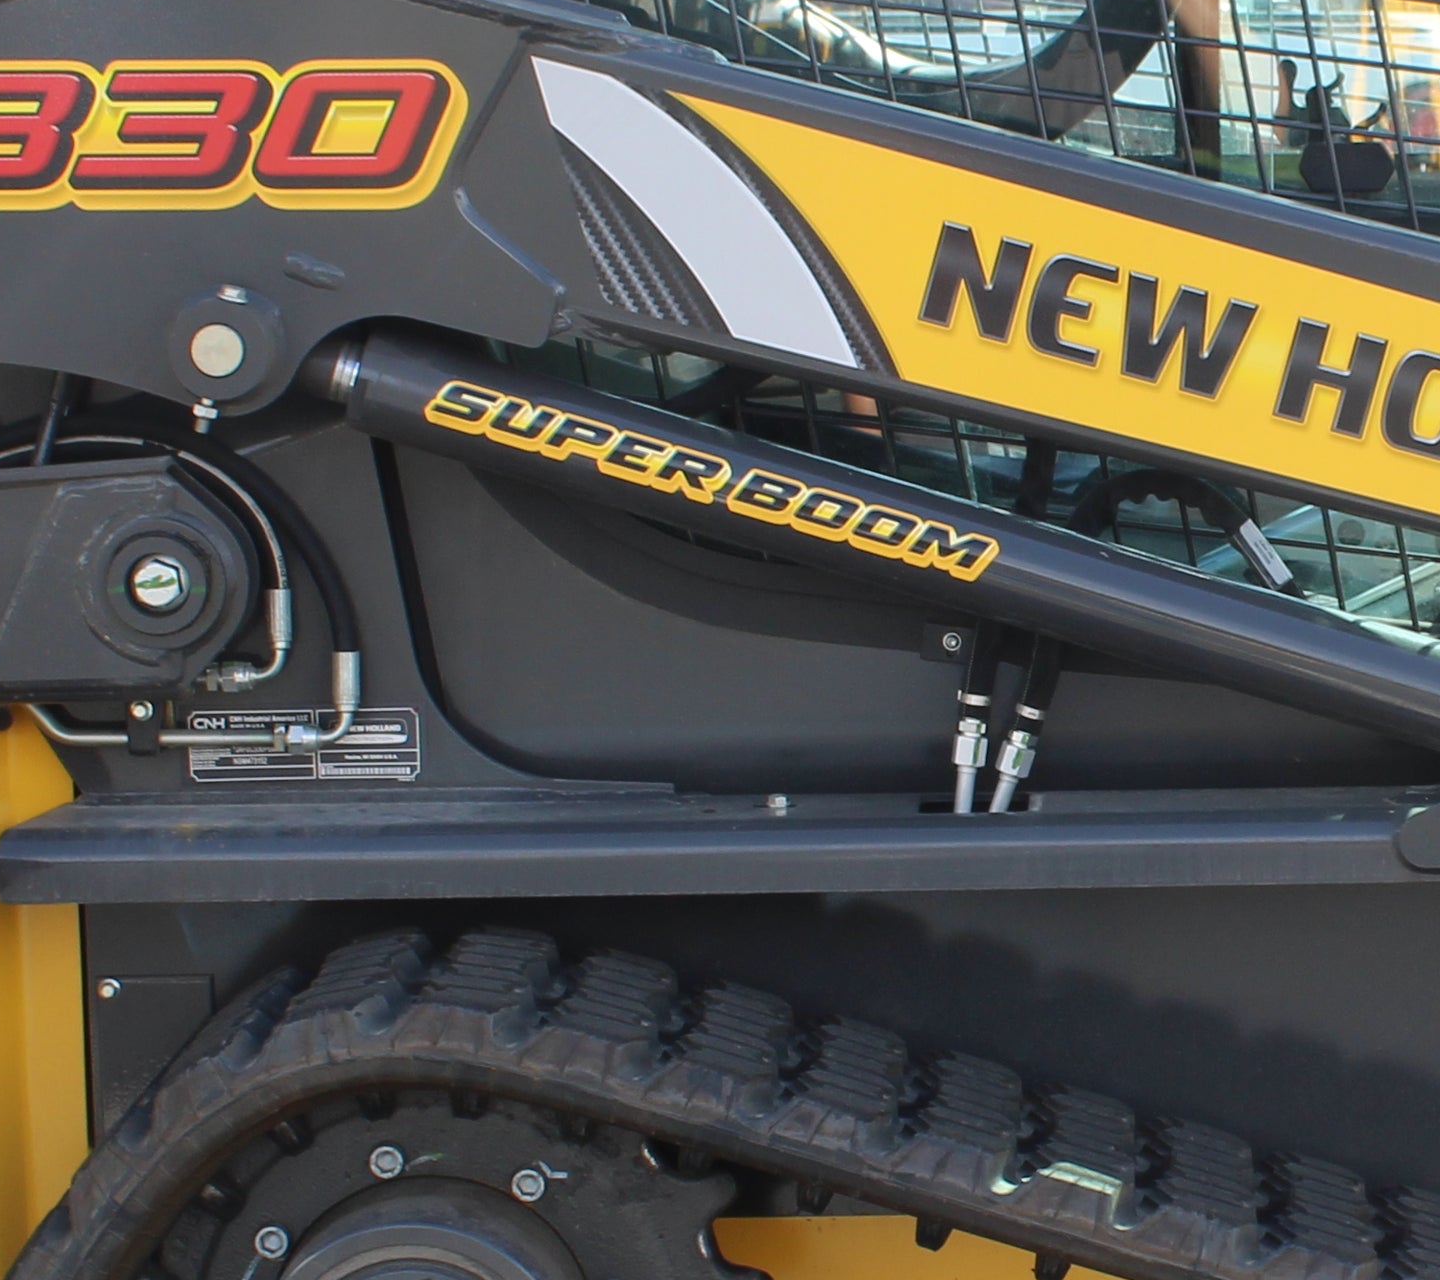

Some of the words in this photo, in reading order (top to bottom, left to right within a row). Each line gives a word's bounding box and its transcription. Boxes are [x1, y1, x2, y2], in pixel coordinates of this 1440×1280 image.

[917, 219, 1258, 398] NEW
[424, 380, 732, 504] SUPER
[727, 468, 1000, 582] BOOM
[193, 718, 226, 729] CNH
[366, 724, 402, 732] HOLLAND
